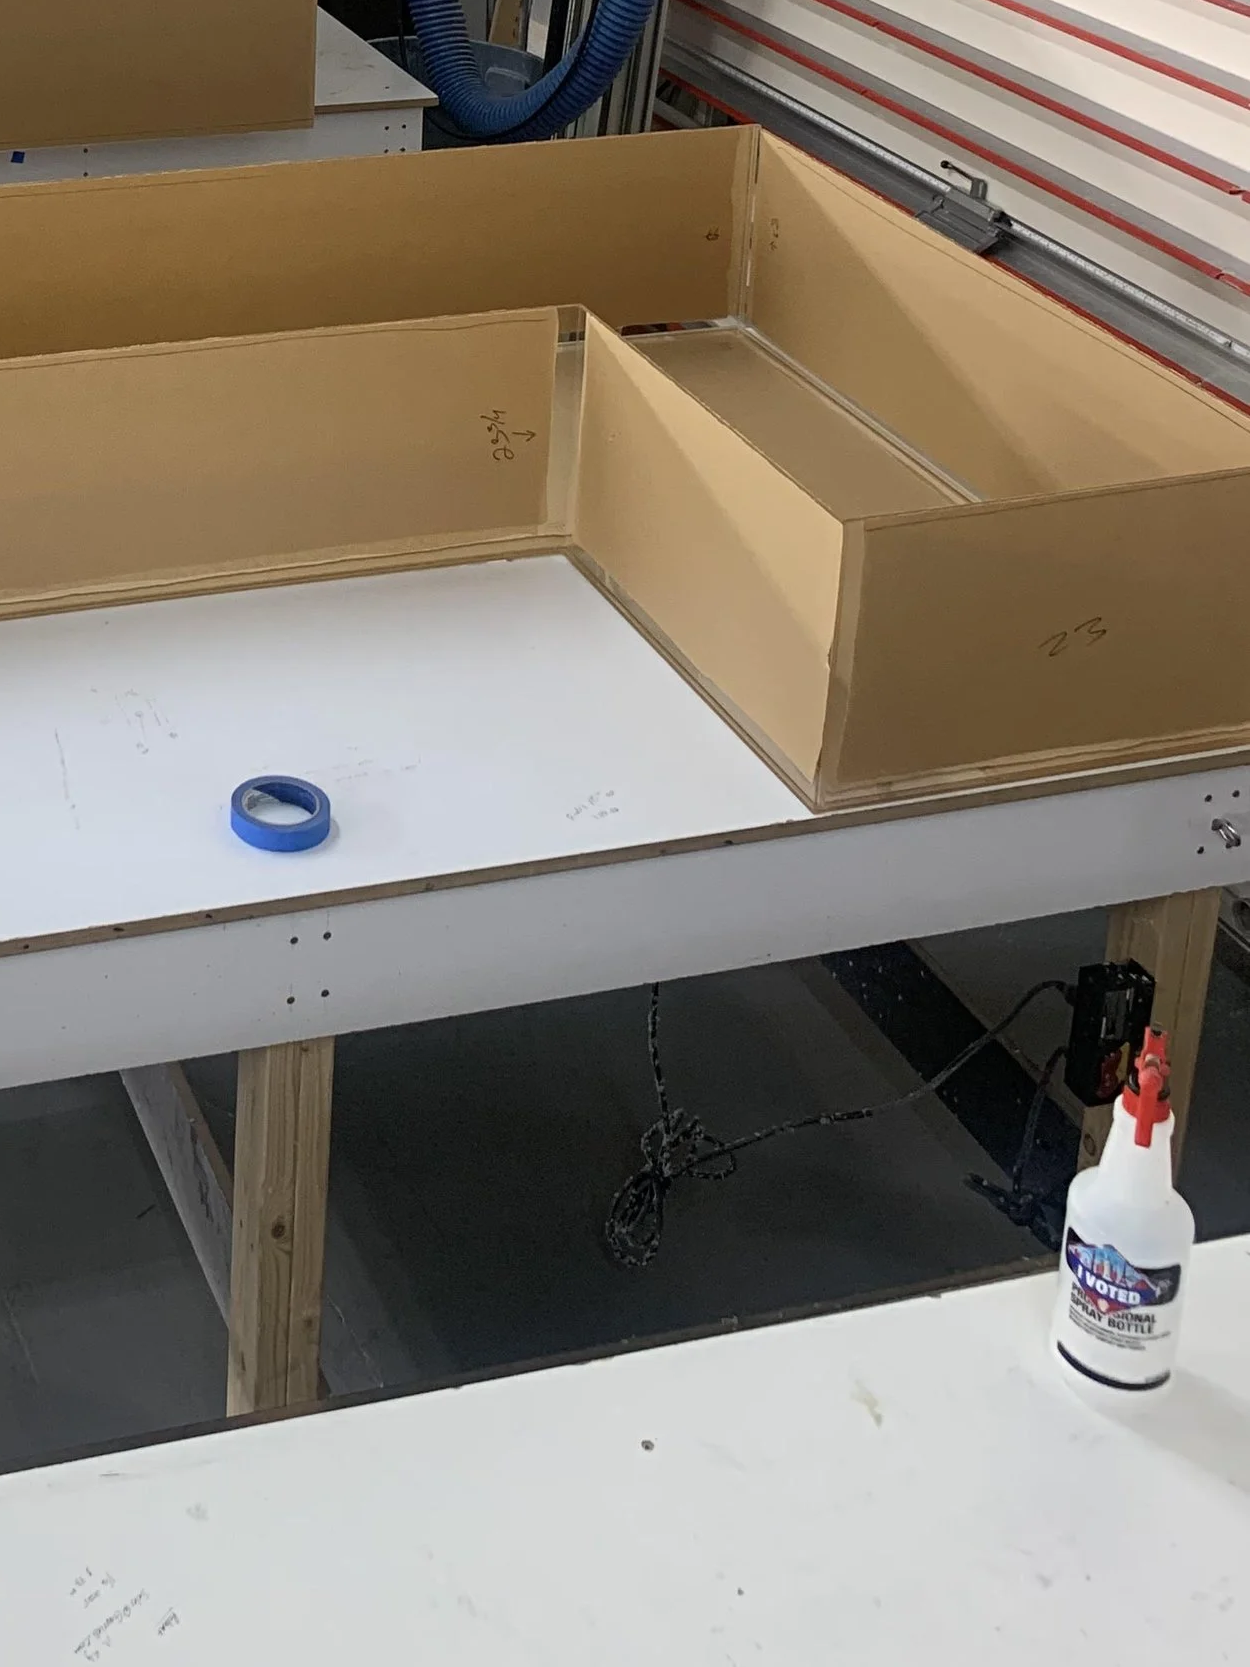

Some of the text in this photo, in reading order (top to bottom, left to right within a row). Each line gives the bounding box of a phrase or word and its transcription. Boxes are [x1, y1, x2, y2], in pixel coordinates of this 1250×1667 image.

[1077, 1264, 1141, 1305] I VOTED
[1071, 1291, 1154, 1335] SPRAY BOTTLE
